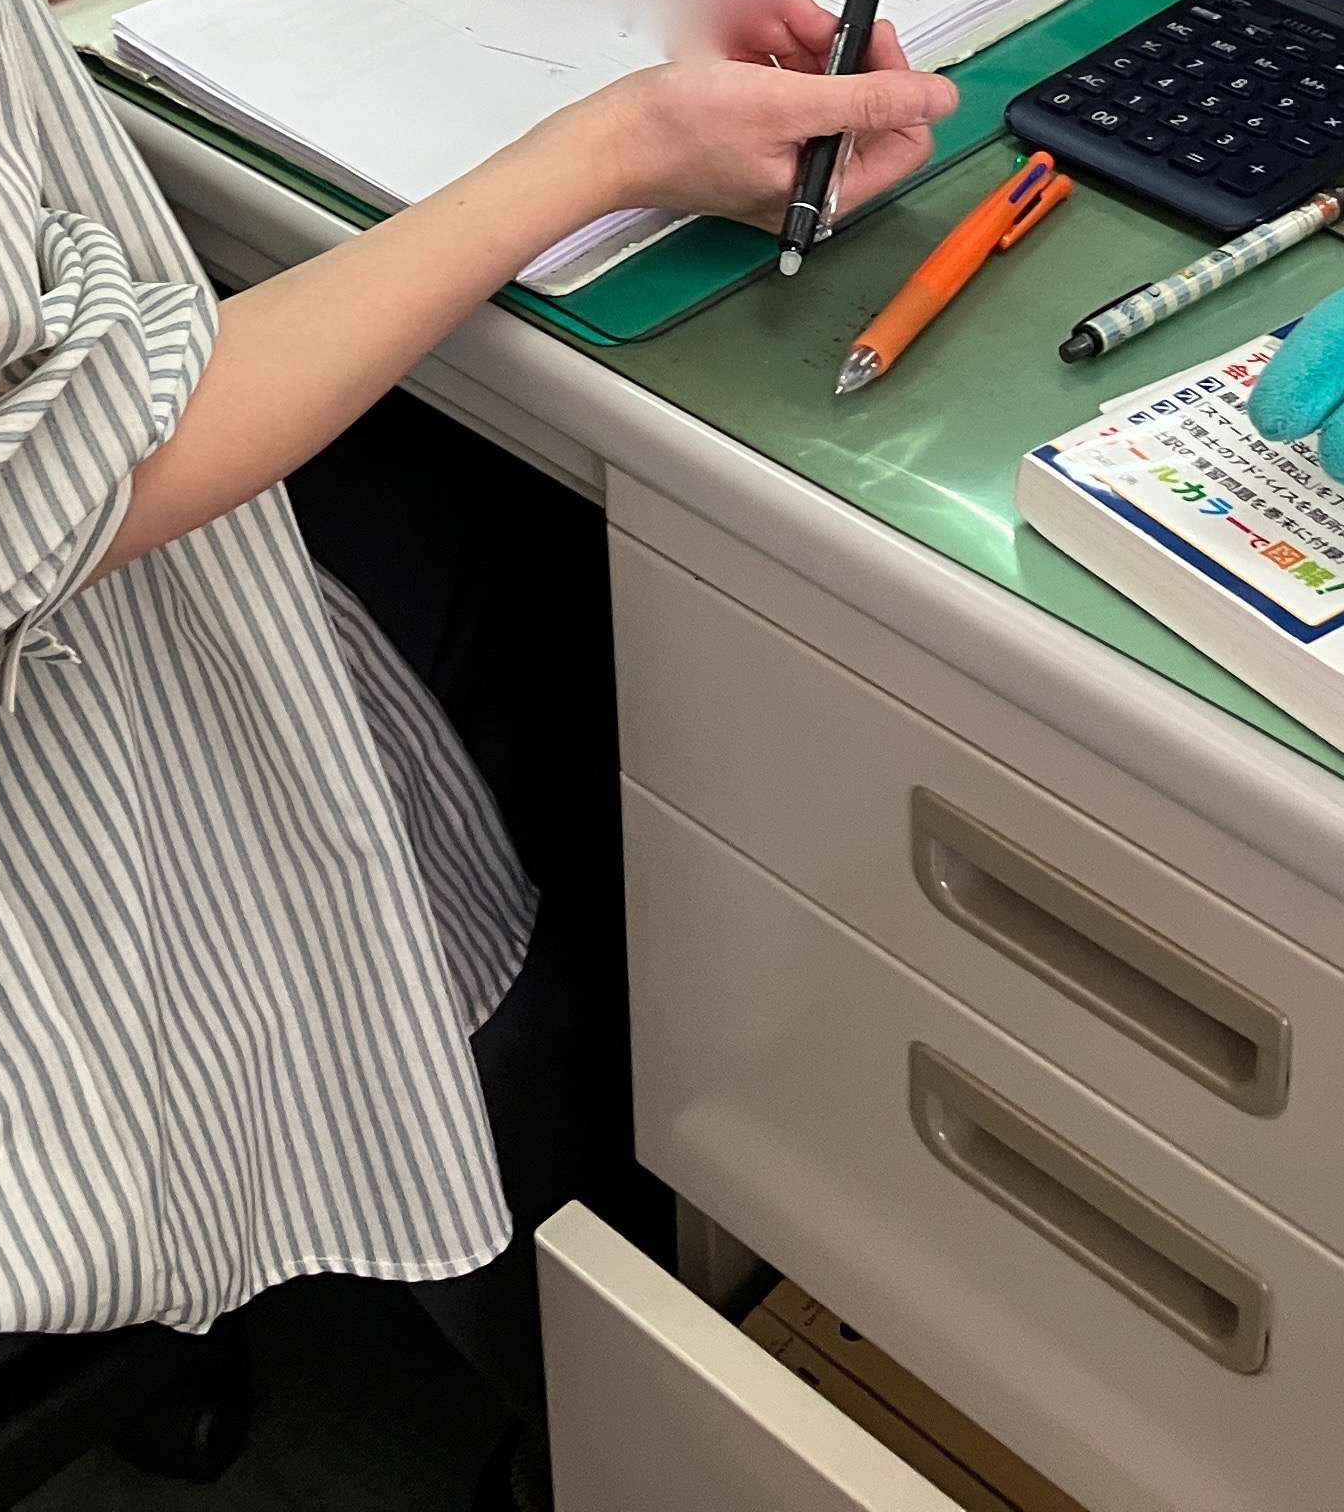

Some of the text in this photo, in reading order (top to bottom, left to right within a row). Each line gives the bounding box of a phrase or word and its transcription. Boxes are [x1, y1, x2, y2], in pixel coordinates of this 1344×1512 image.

[1166, 22, 1193, 36] MC
[1211, 40, 1237, 53] MR
[1114, 58, 1131, 68] C
[1186, 59, 1204, 69] 7
[1078, 74, 1106, 87] AC
[1157, 78, 1174, 87] 4
[1231, 78, 1248, 88] 8
[1053, 93, 1070, 104] 0
[1128, 95, 1141, 105] 1
[1201, 96, 1220, 107] 5
[1277, 97, 1294, 107] 9
[1091, 110, 1118, 126] 00
[1169, 114, 1188, 126] 2
[1247, 117, 1264, 126] 6
[1216, 134, 1234, 145] 3
